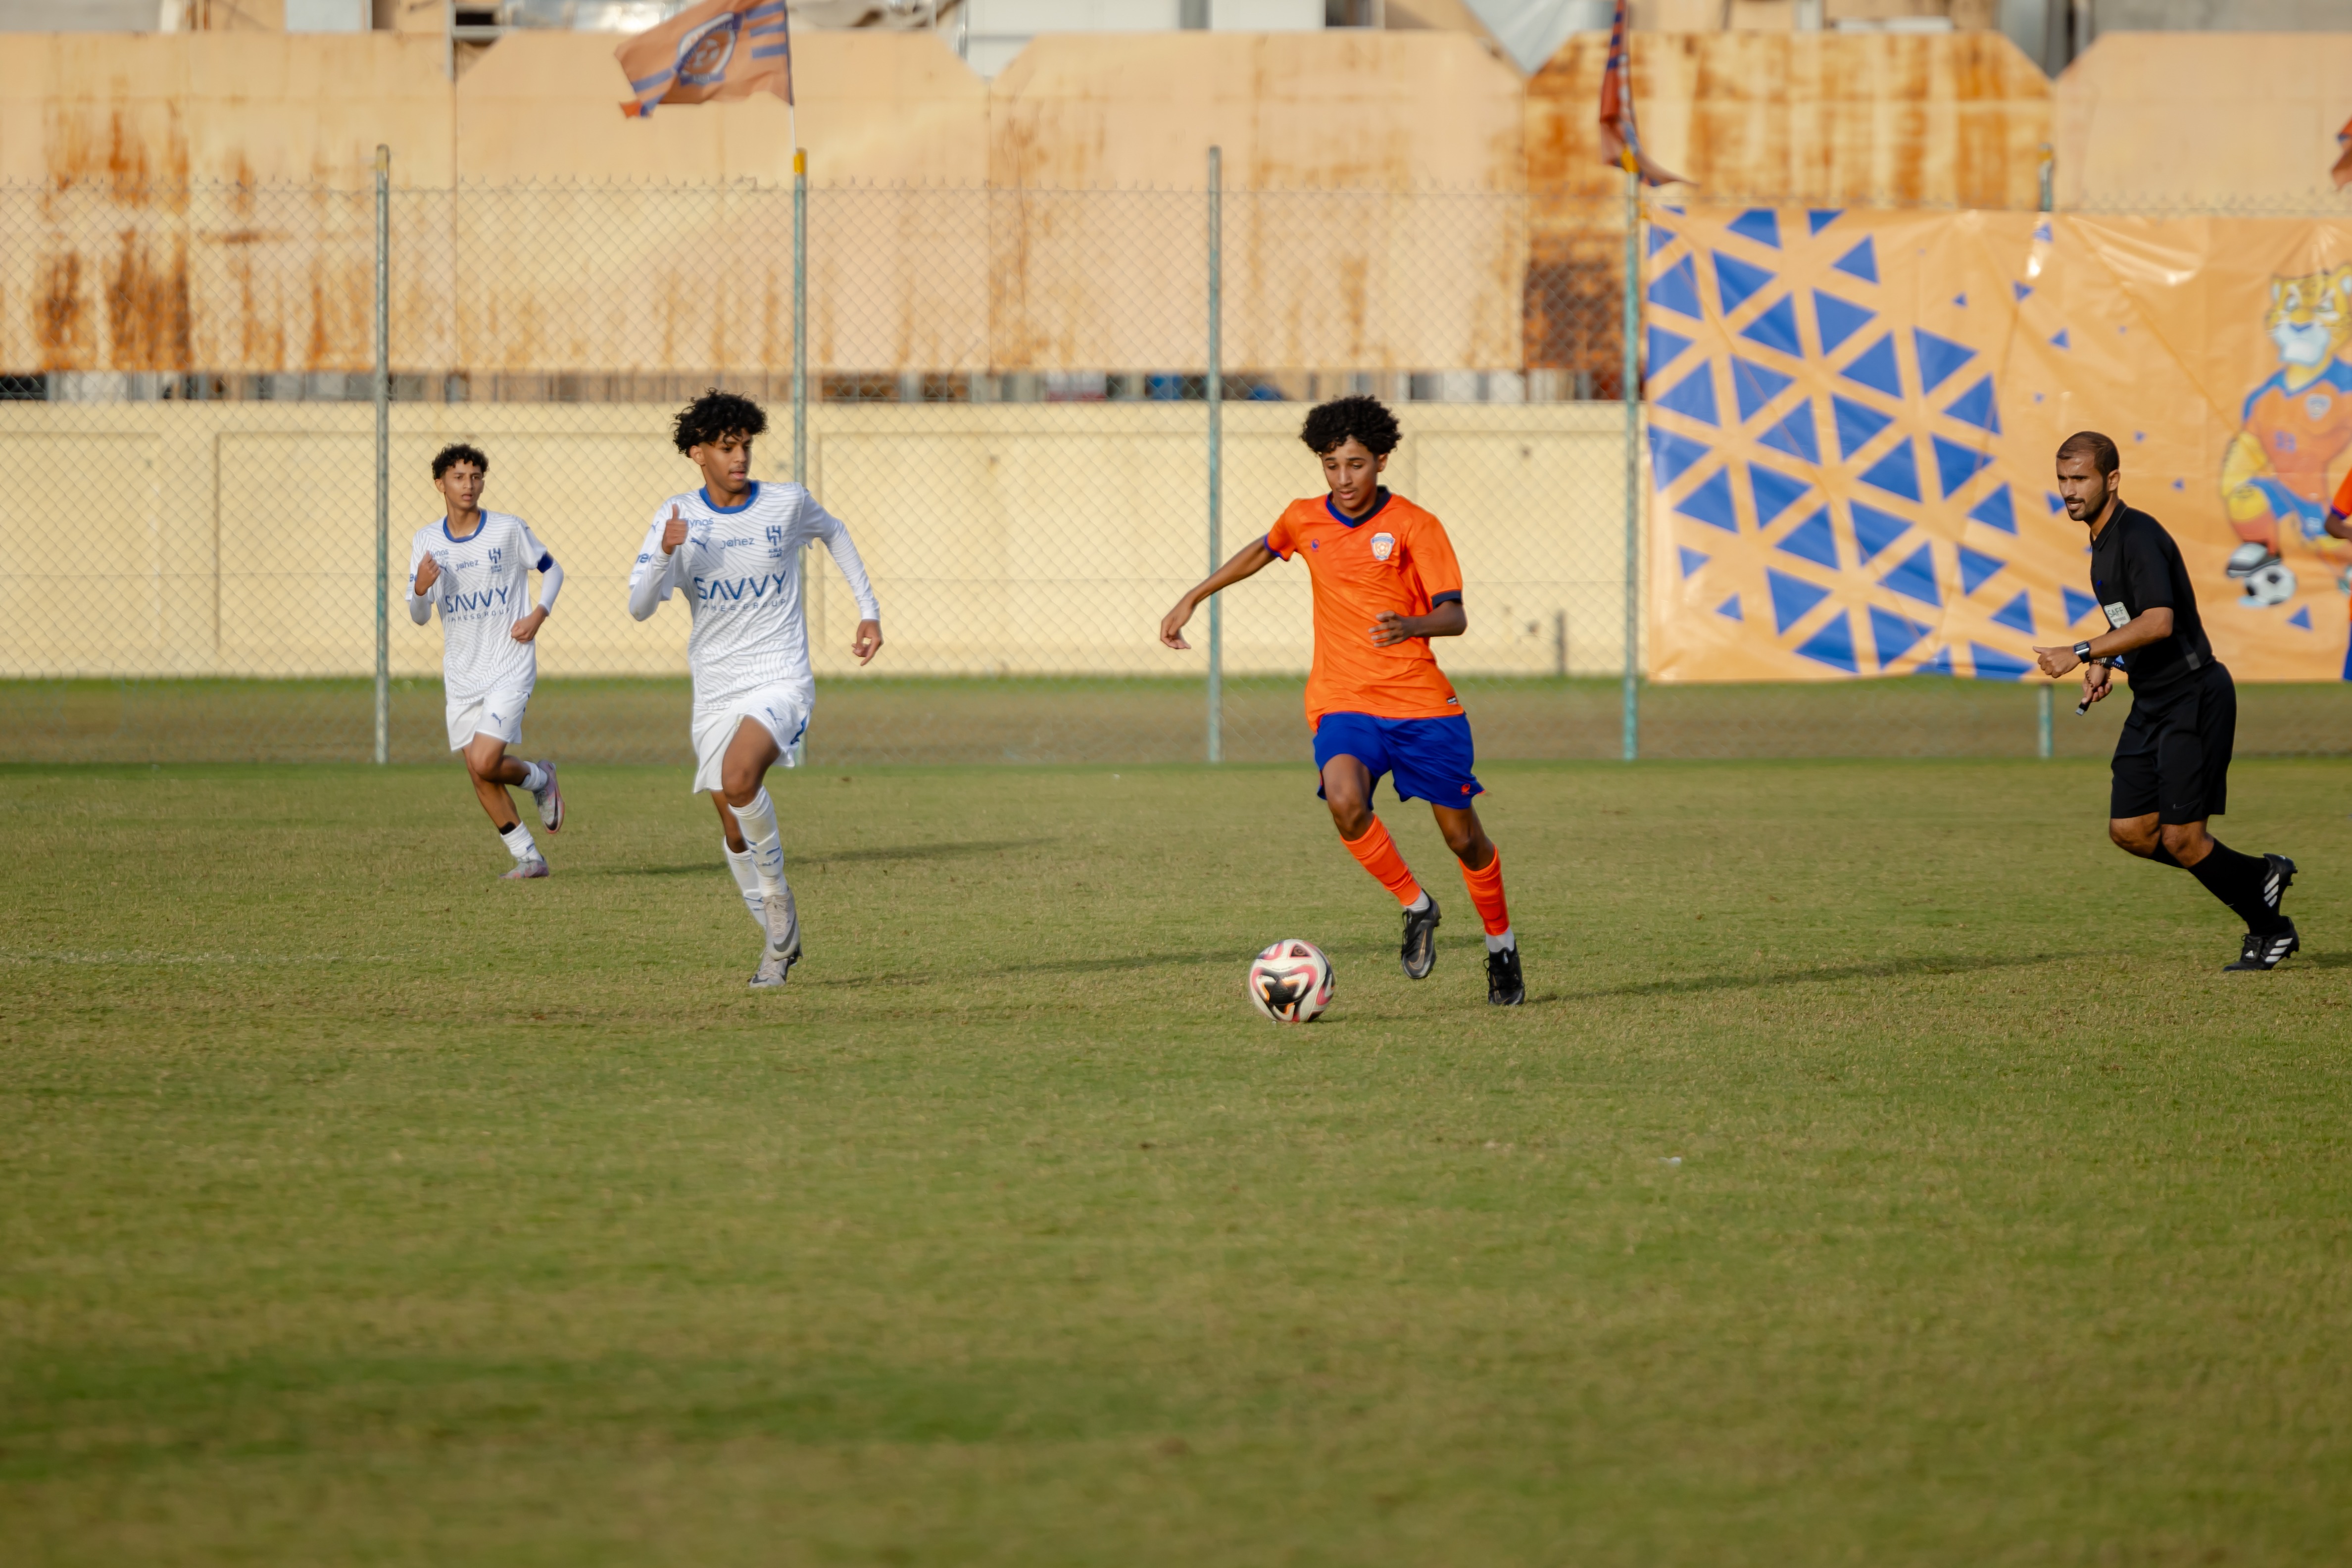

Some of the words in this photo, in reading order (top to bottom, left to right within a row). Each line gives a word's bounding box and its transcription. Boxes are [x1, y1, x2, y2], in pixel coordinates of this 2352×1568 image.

[720, 537, 755, 550] jahez
[455, 560, 479, 571] jahez
[694, 570, 786, 600] SAVVY
[445, 586, 508, 613] SAVVY
[2107, 606, 2123, 618] SAFF
